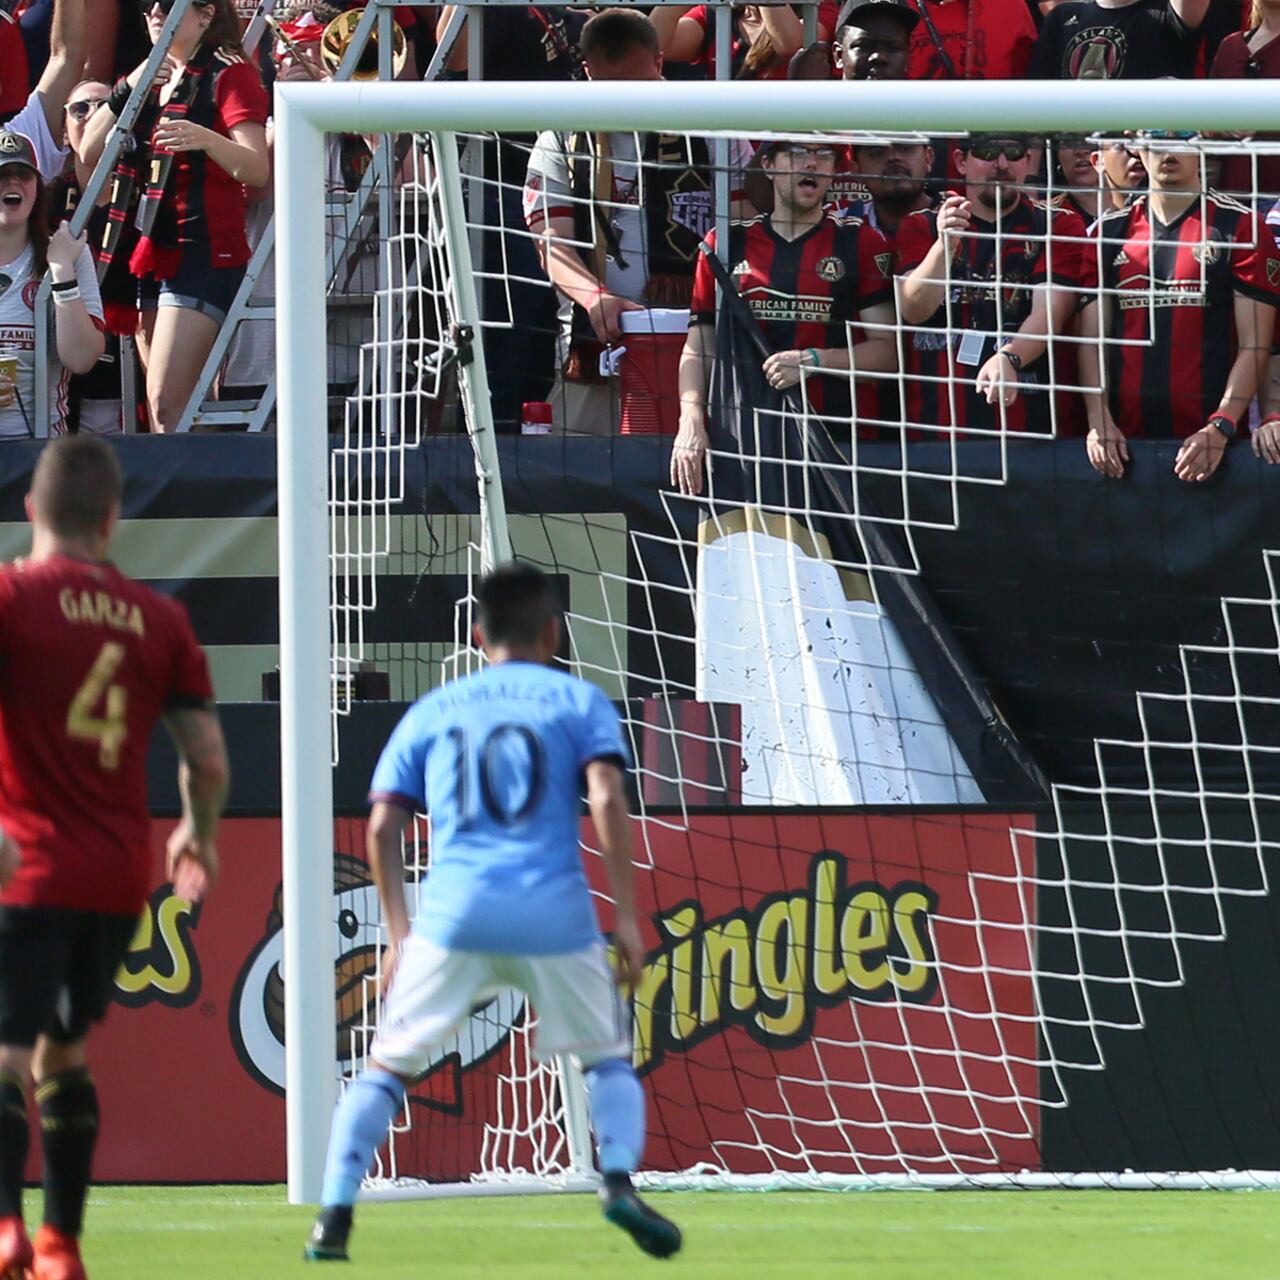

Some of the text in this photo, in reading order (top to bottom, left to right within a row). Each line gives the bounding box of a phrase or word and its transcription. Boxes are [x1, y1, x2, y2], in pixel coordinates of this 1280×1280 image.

[827, 182, 868, 192] AMERIC
[749, 299, 832, 313] ERICAN FAMILY
[753, 311, 831, 322] SURANCE
[0, 330, 34, 339] FAMIL
[59, 587, 145, 640] GARZA
[66, 641, 127, 771] 4
[447, 723, 546, 833] 10
[612, 858, 932, 1071] ringles
